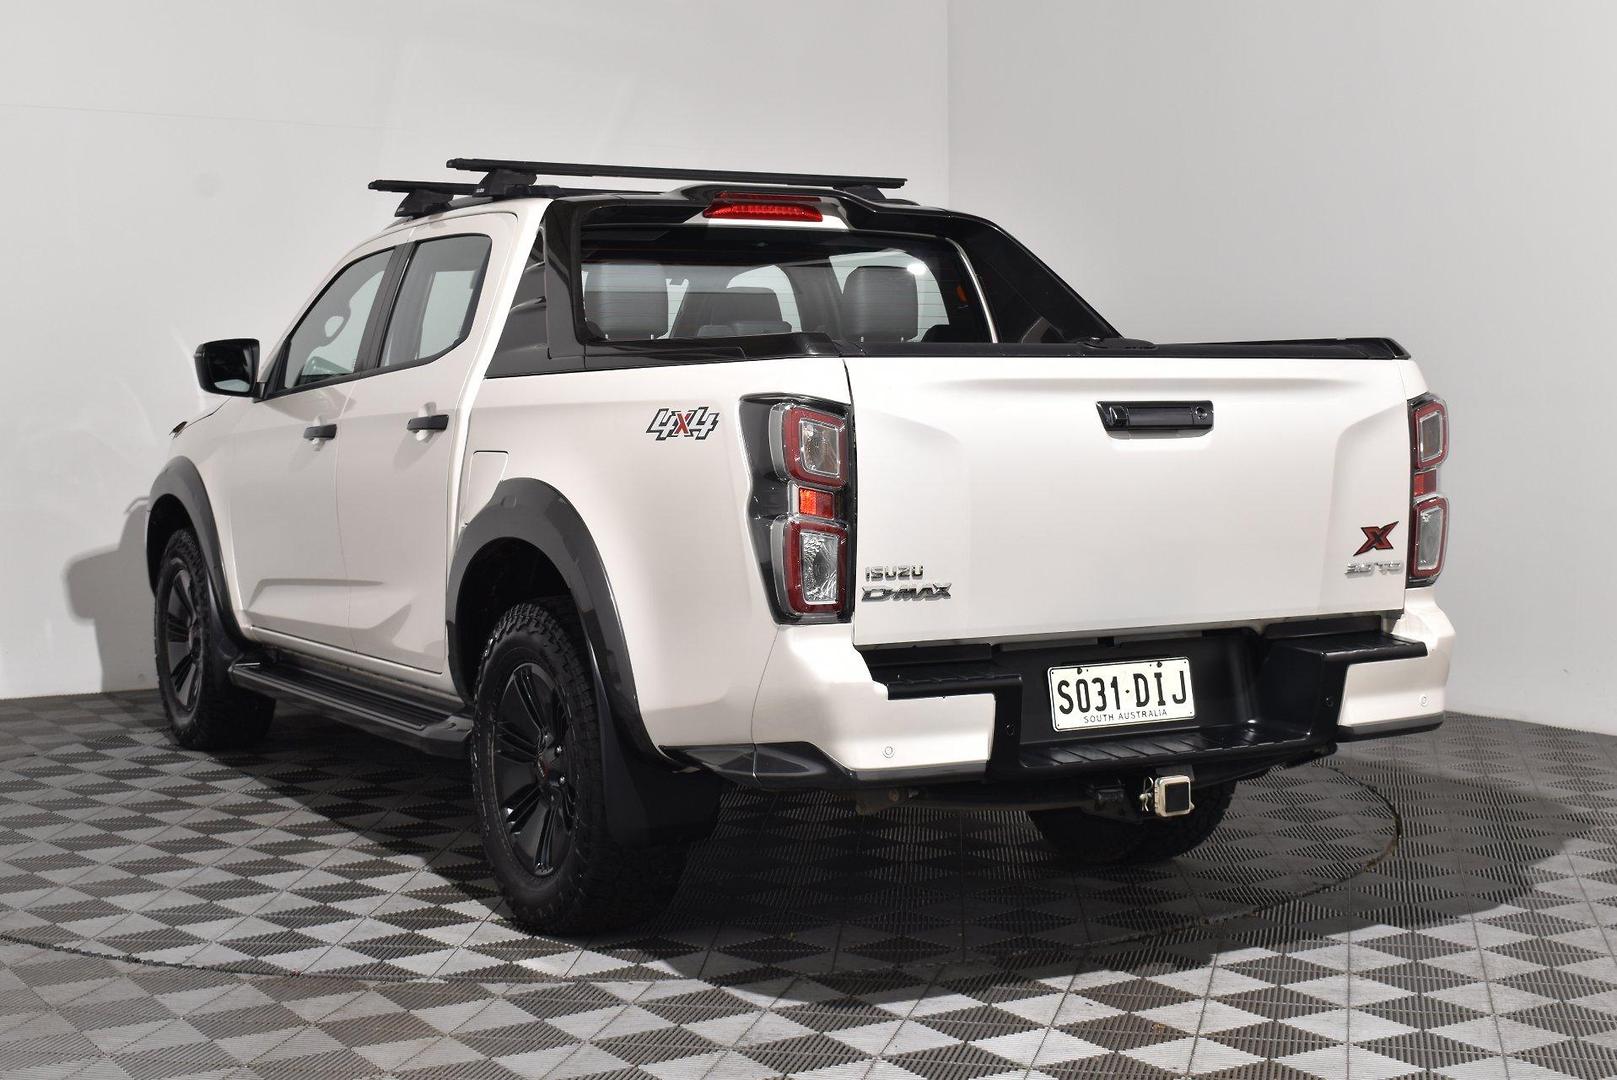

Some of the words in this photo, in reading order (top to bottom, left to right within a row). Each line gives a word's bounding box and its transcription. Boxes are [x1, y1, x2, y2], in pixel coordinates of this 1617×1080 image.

[865, 564, 924, 581] ISUZU
[861, 583, 952, 602] D-MAX
[1083, 713, 1115, 724] SOUTH
[1118, 708, 1168, 720] AUSTRALIA
